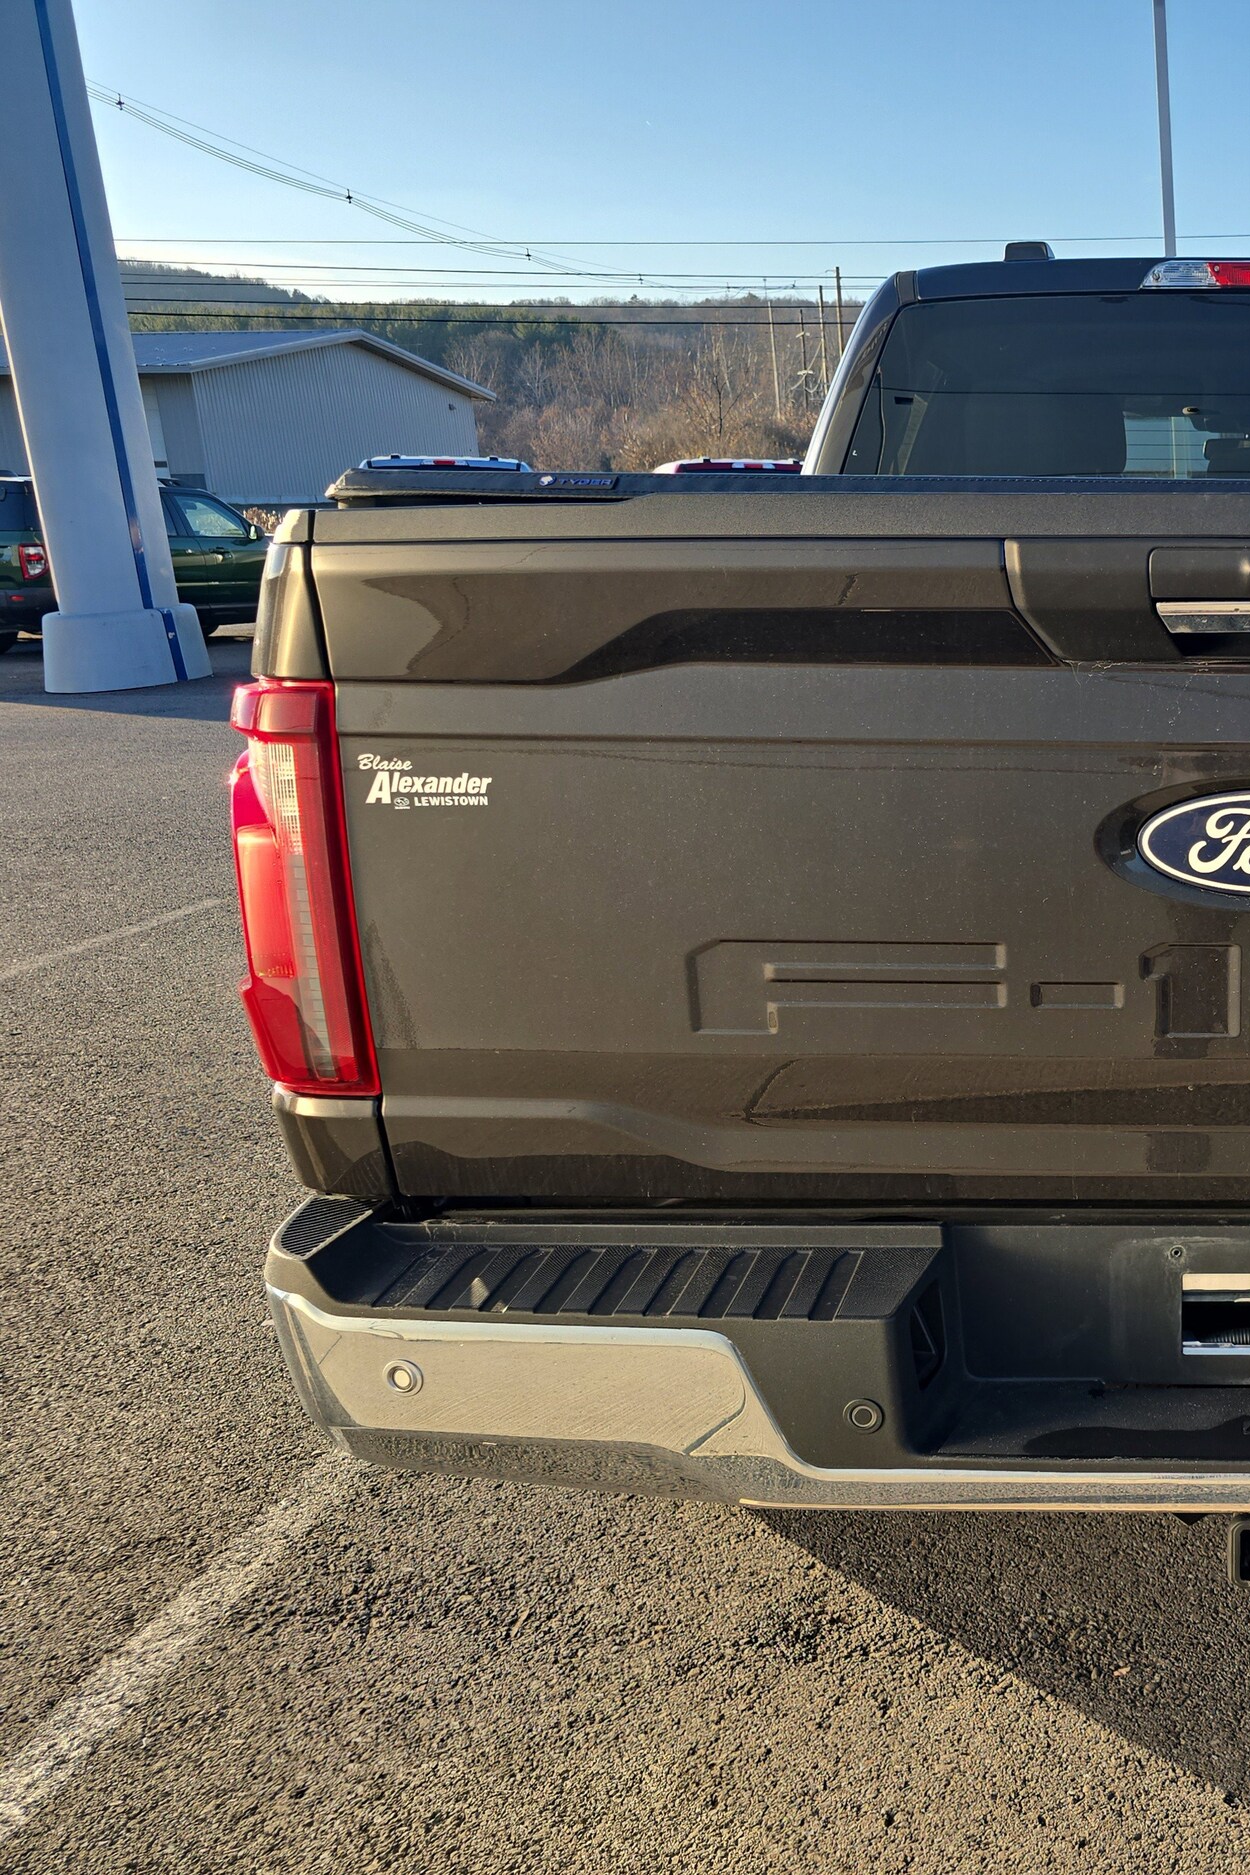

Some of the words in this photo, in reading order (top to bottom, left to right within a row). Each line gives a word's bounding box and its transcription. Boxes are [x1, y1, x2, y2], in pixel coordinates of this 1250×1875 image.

[357, 753, 413, 771] Blaise
[365, 771, 492, 804] Alexander
[414, 796, 489, 807] LEWISTOWN
